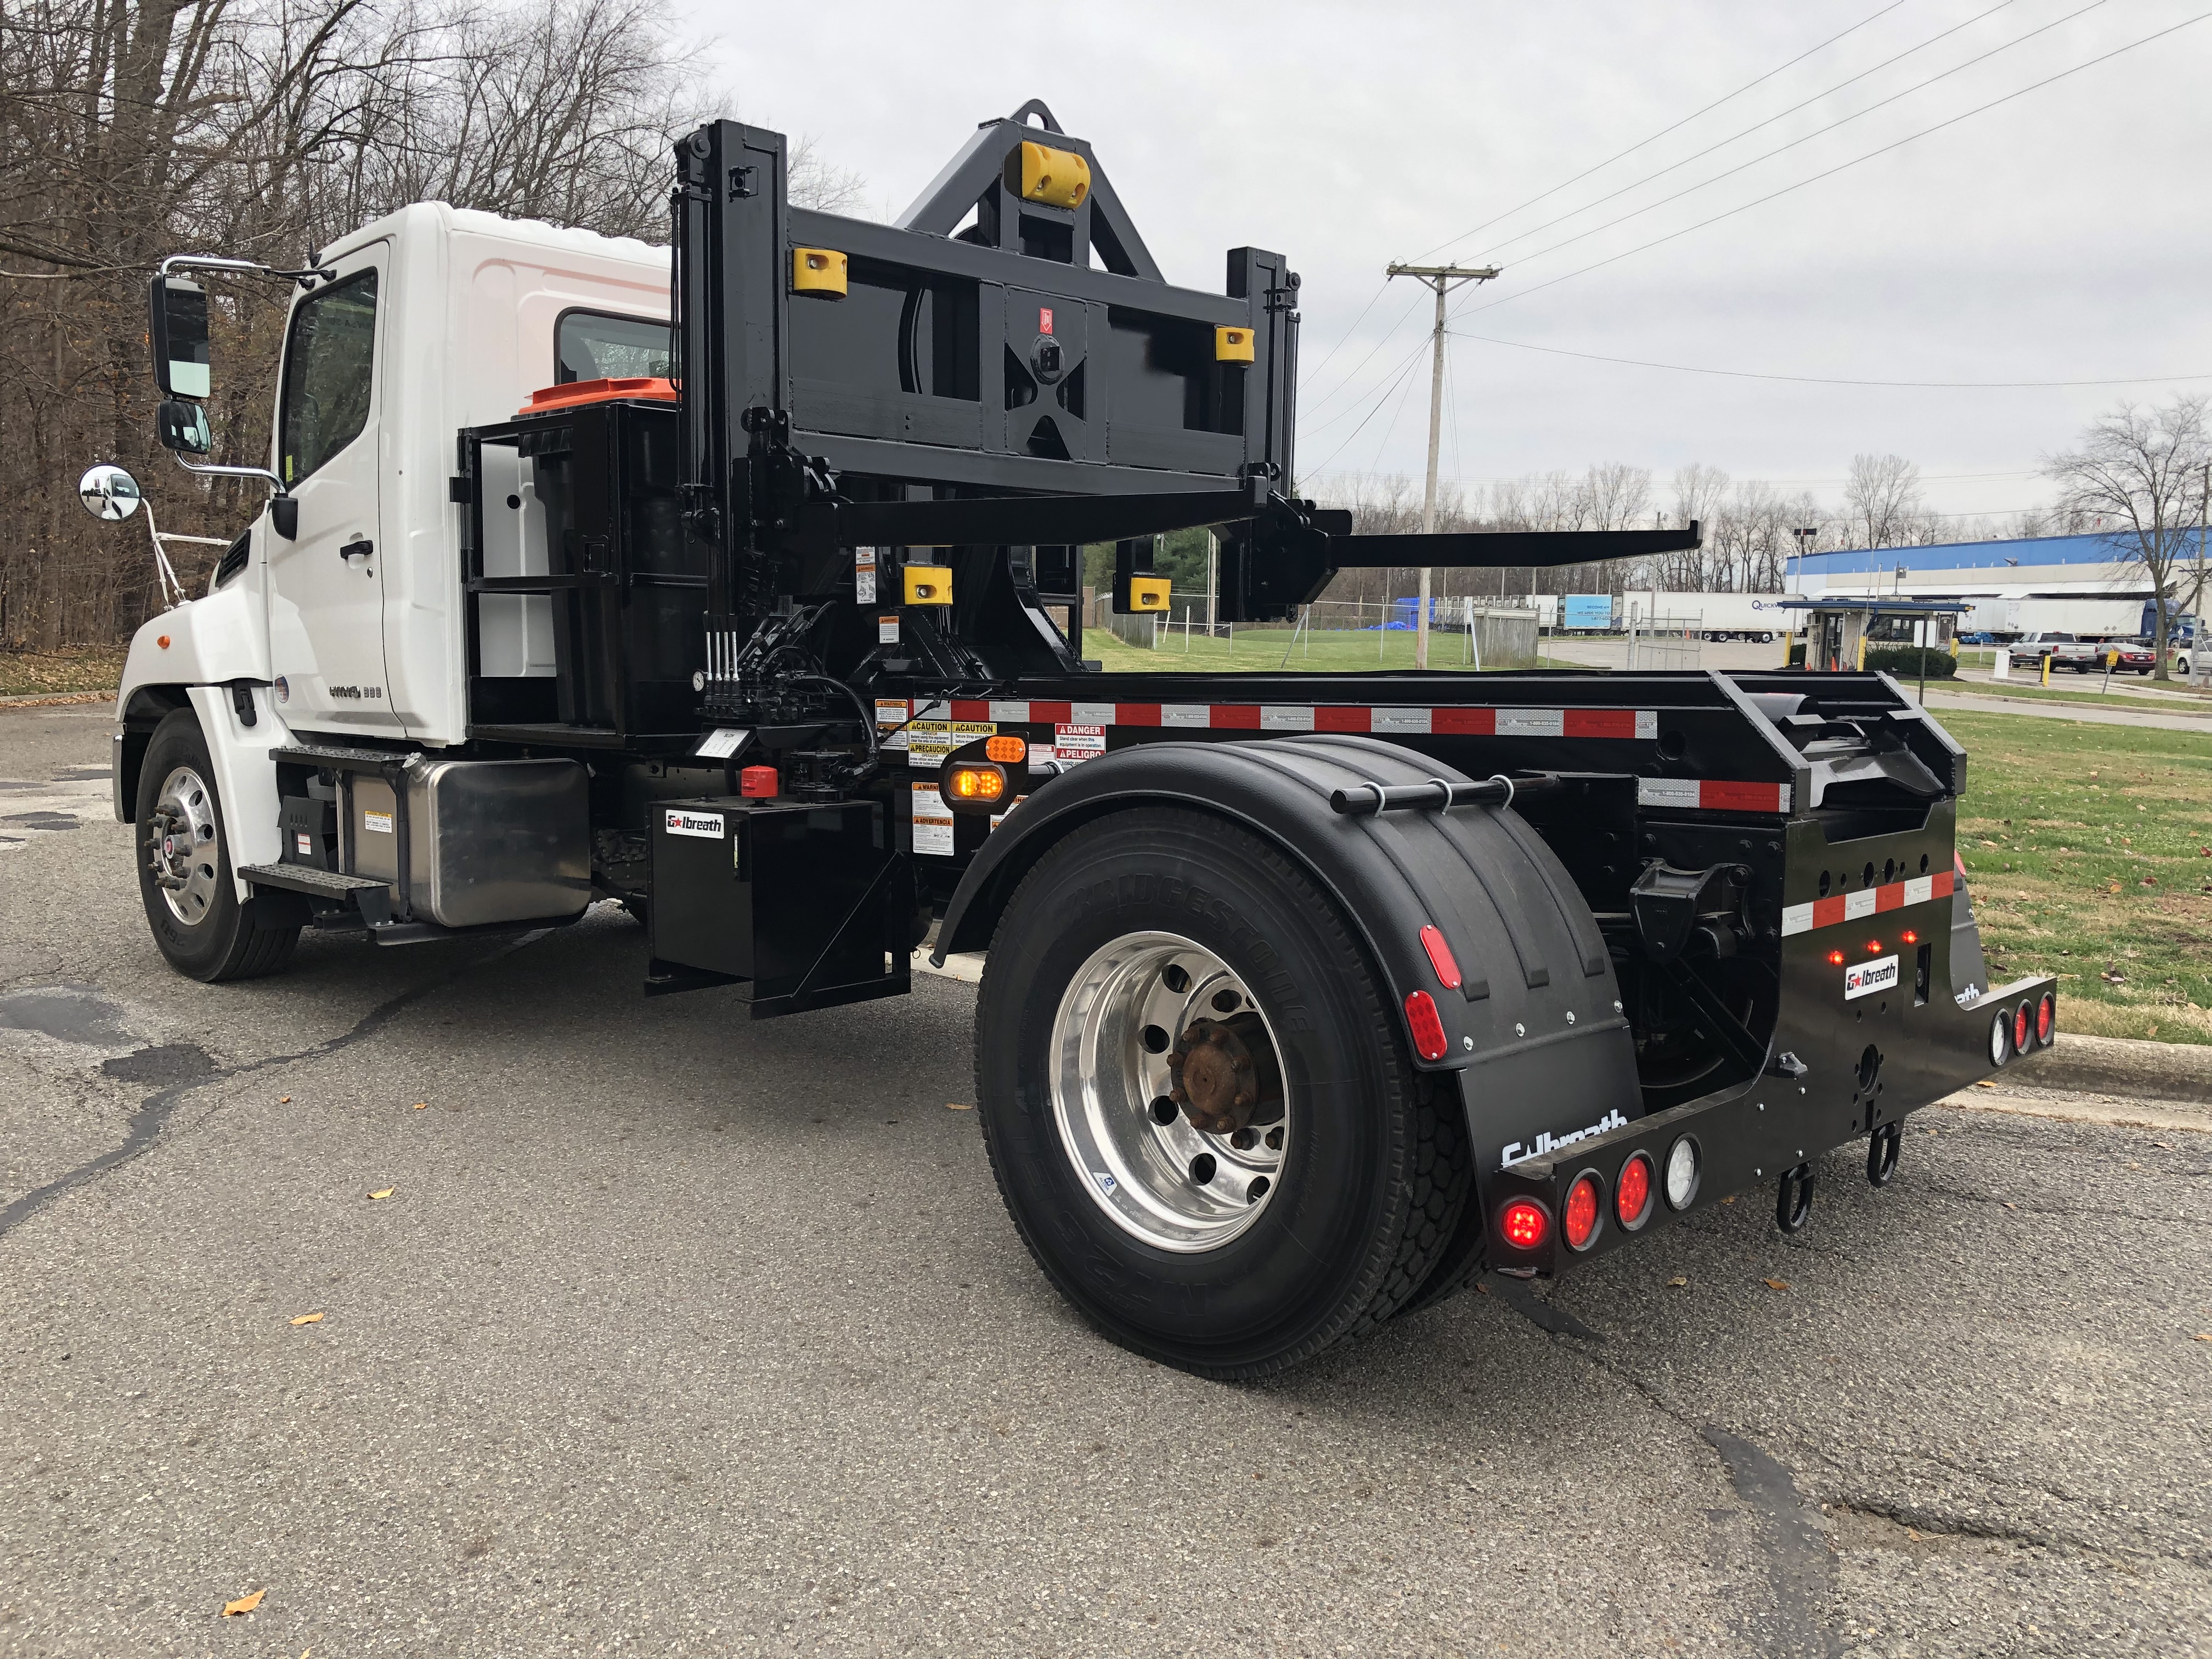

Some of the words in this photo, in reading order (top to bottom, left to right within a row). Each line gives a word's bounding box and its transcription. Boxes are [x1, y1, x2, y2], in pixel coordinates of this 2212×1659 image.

[1752, 600, 1782, 611] QUICKW
[329, 685, 361, 698] HINO
[916, 723, 947, 731] CAUTION
[961, 724, 993, 732] CAUTION
[1067, 726, 1101, 735] DANGER
[916, 744, 950, 754] PRECAUCION
[1066, 749, 1102, 759] PELIGRO
[1066, 872, 1313, 1032] BRIDGESTONE
